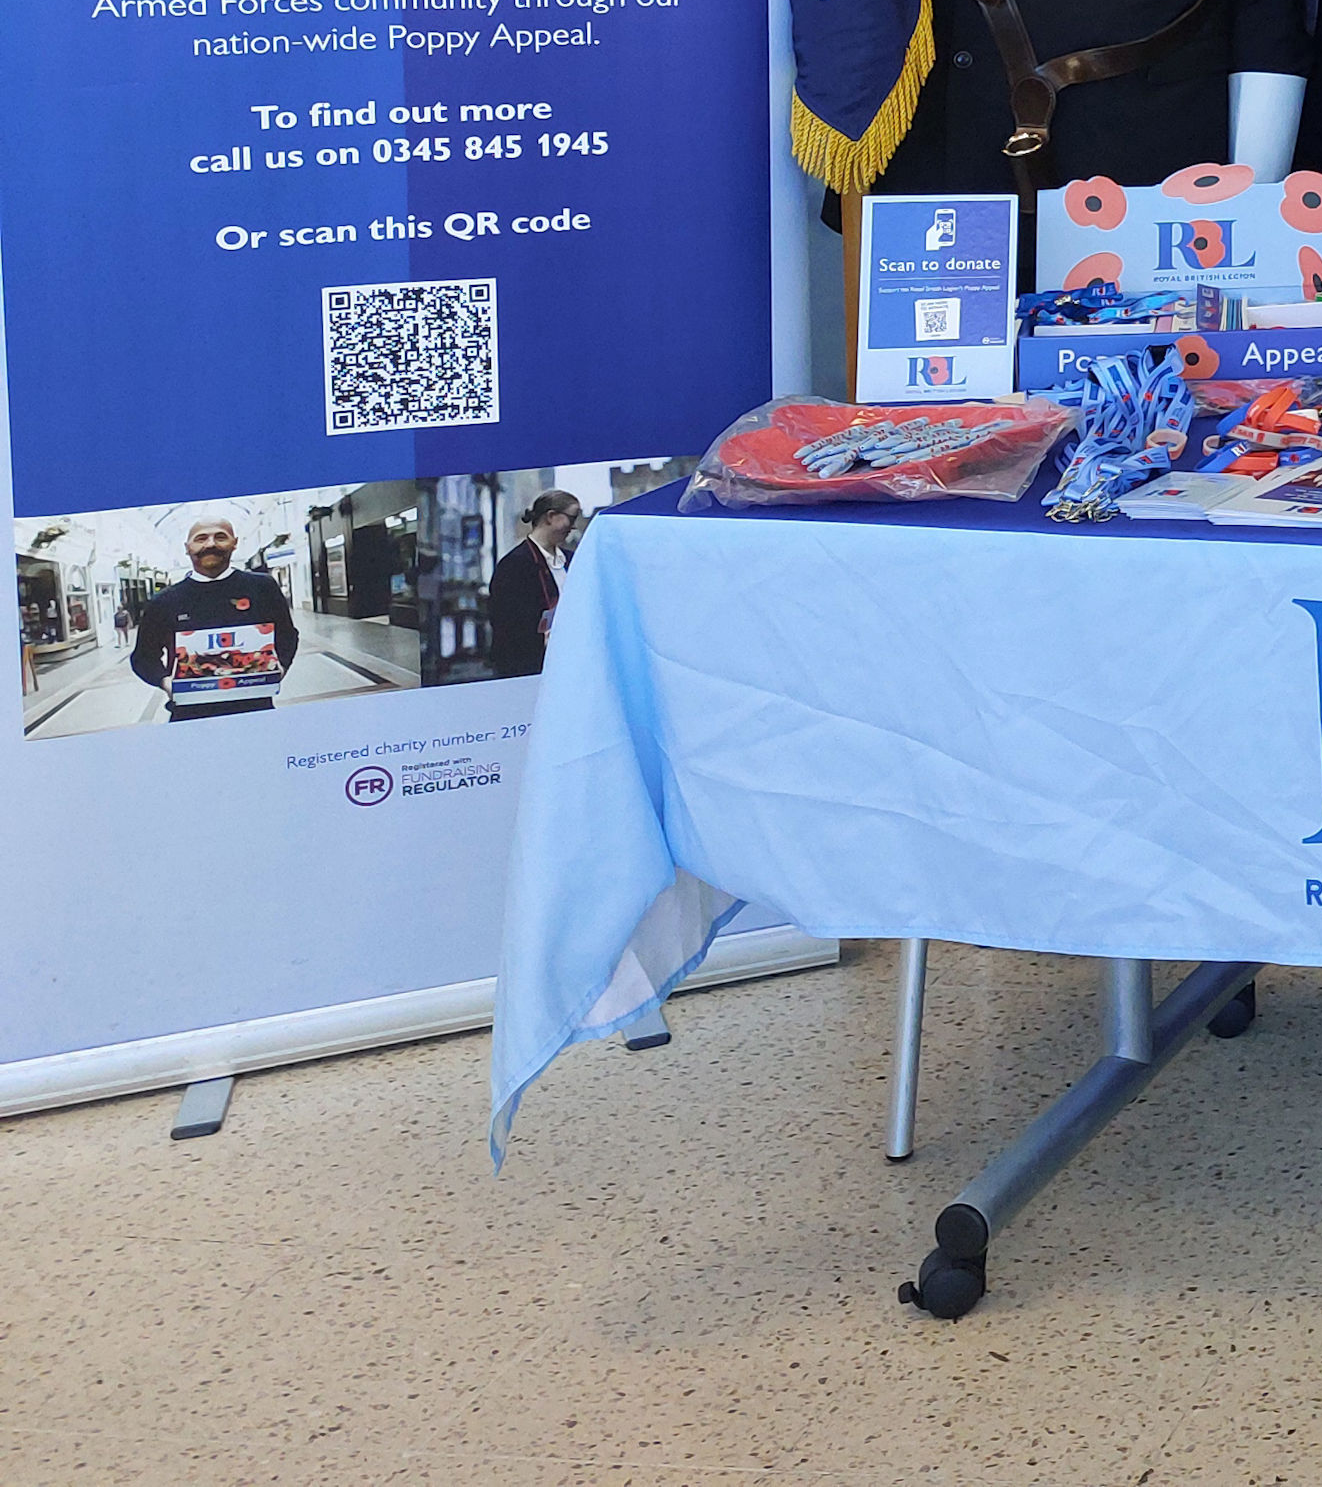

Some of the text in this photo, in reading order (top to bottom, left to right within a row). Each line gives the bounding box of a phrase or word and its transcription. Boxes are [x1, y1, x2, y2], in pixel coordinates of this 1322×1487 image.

[192, 22, 600, 57] nation-wide Poppy Appeal.
[252, 98, 553, 130] To find out more
[190, 131, 610, 174] call us on 0345 845 1945
[216, 208, 592, 253] Or scan this QR code
[879, 258, 1002, 272] Scan to donate
[1185, 273, 1220, 282] BRITISH
[287, 745, 369, 770] Registered
[375, 739, 427, 756] charity
[432, 730, 496, 749] number:
[402, 756, 472, 772] Registered with
[402, 762, 501, 784] FUNDRAISING
[354, 778, 386, 796] FR
[402, 773, 501, 796] REGULATOR
